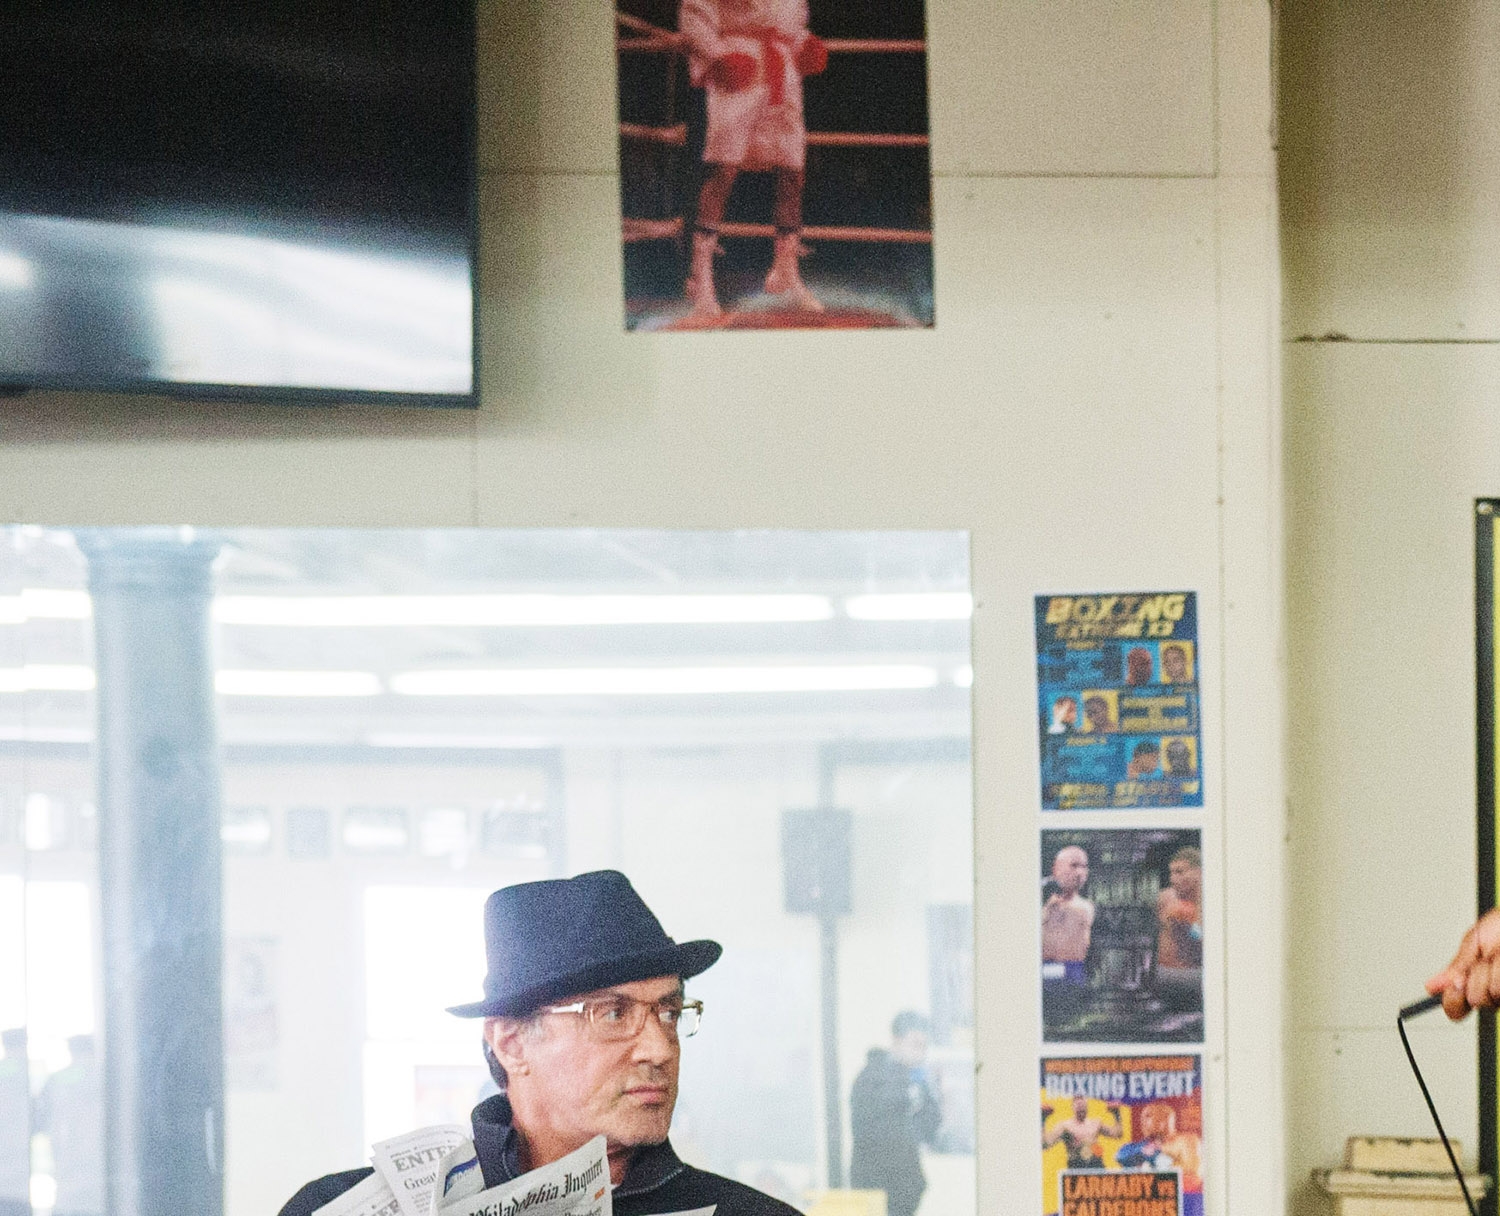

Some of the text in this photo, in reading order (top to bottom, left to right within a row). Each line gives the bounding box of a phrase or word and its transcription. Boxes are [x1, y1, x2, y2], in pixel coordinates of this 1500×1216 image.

[1045, 1069, 1196, 1099] BOXING EVENT
[392, 1144, 457, 1171] ENTE
[561, 1158, 603, 1198] Inquirer
